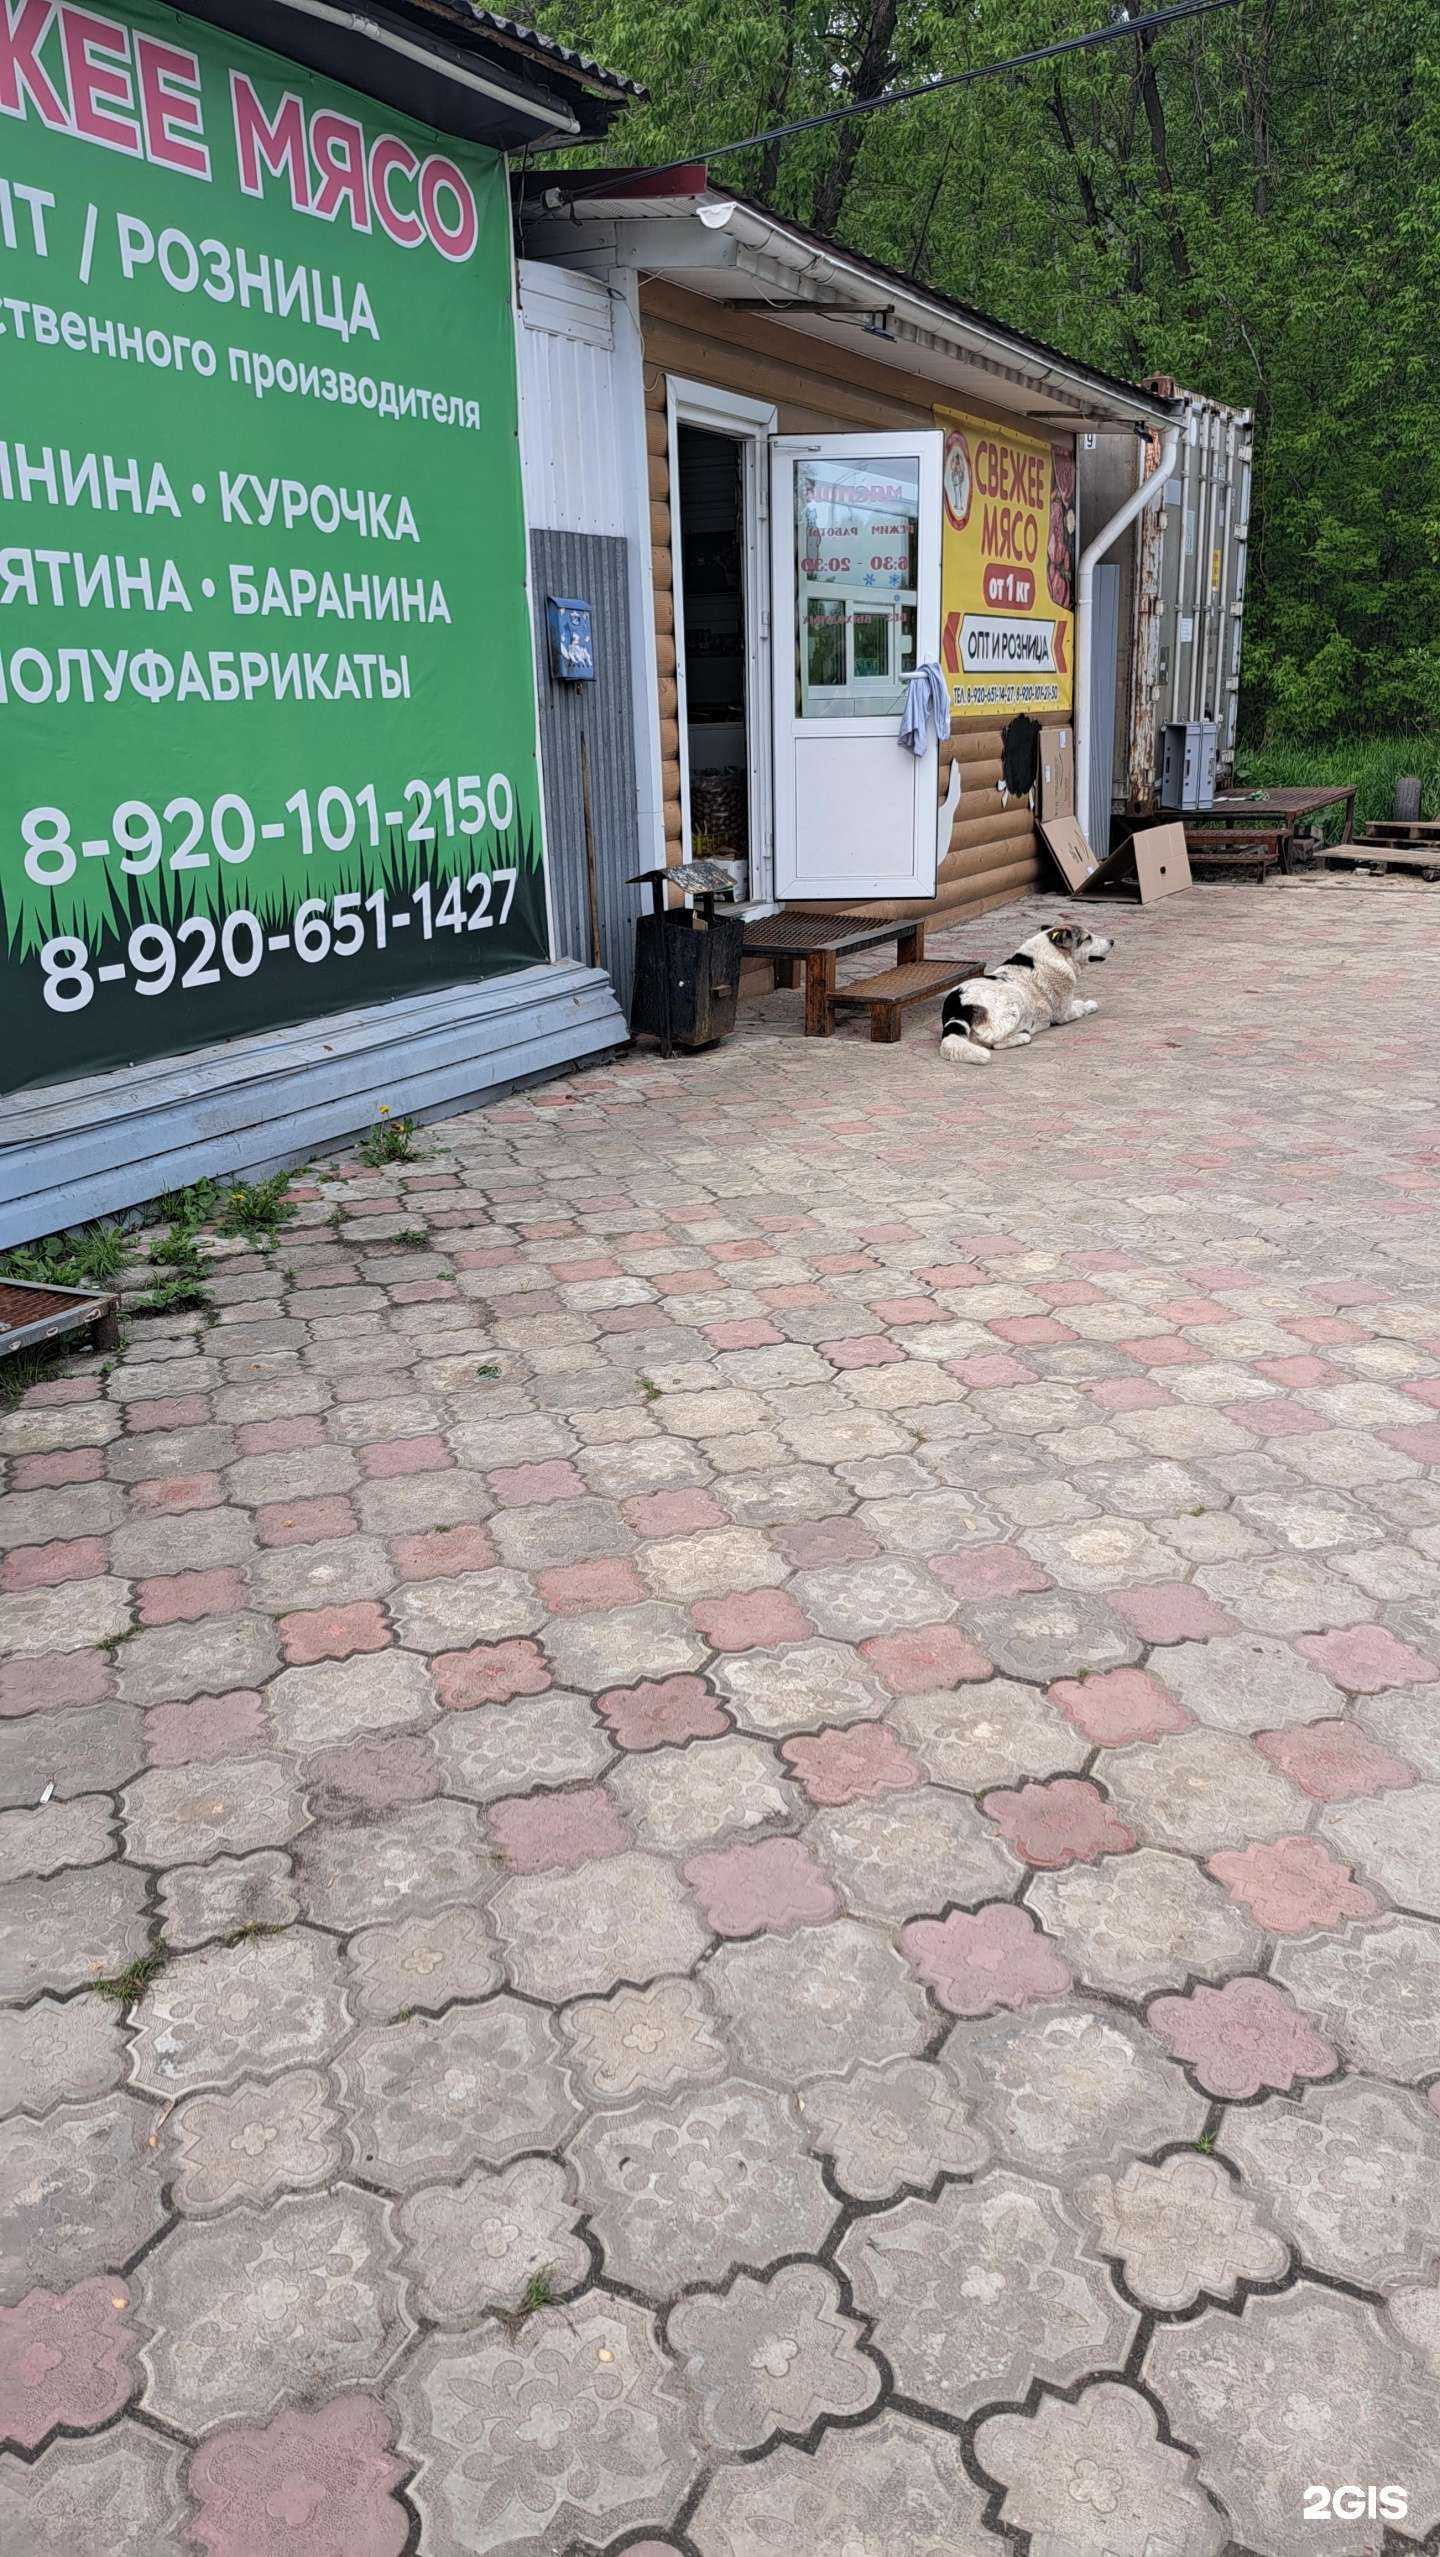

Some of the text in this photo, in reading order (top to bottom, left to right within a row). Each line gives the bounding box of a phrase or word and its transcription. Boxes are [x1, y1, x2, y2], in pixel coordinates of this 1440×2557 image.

[229, 69, 478, 262] МЯСО
[117, 213, 379, 340] РОЗНИЦА
[0, 298, 479, 429] твенного производителя
[220, 472, 419, 542] КУРОЧКА
[975, 440, 1044, 510] СВЕЖЕЕ
[981, 503, 1038, 563] МЯСО
[0, 548, 451, 623] ЯТИНА БАРАНИНА
[1006, 573, 1014, 601] 1
[0, 648, 410, 703] ОЛУФАБРИКАТЫ
[967, 631, 1049, 664] ОПТ И РОЗНИЦА
[22, 773, 512, 885] 8-920-101-2150
[41, 868, 516, 1011] 8-920-651-1427
